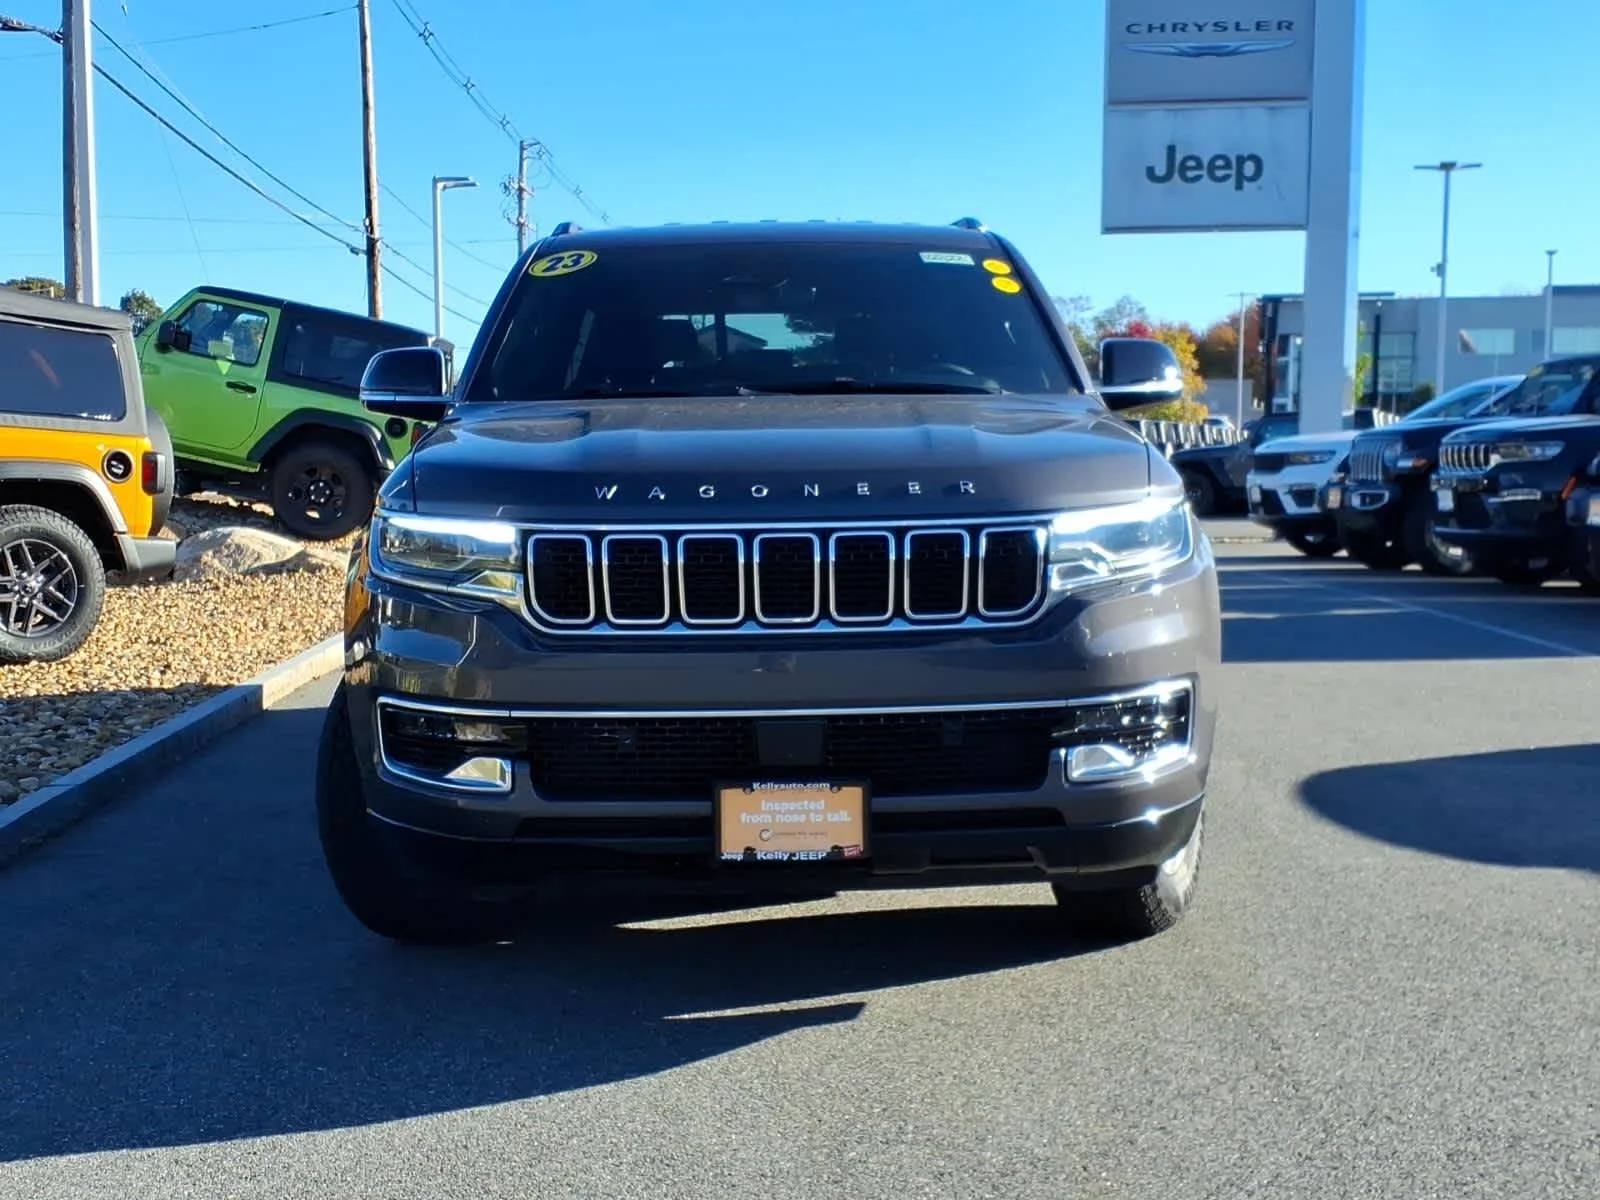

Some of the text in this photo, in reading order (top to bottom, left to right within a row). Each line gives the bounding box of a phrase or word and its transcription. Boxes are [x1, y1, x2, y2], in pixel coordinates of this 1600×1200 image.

[1125, 20, 1295, 35] CHRYSLER
[1145, 144, 1264, 191] Jeep
[594, 480, 976, 500] WAGONEER
[761, 800, 825, 813] Inspected
[740, 813, 772, 824] from
[776, 813, 807, 823] nose
[809, 811, 824, 823] to
[756, 850, 827, 861] Kelly JEEP
